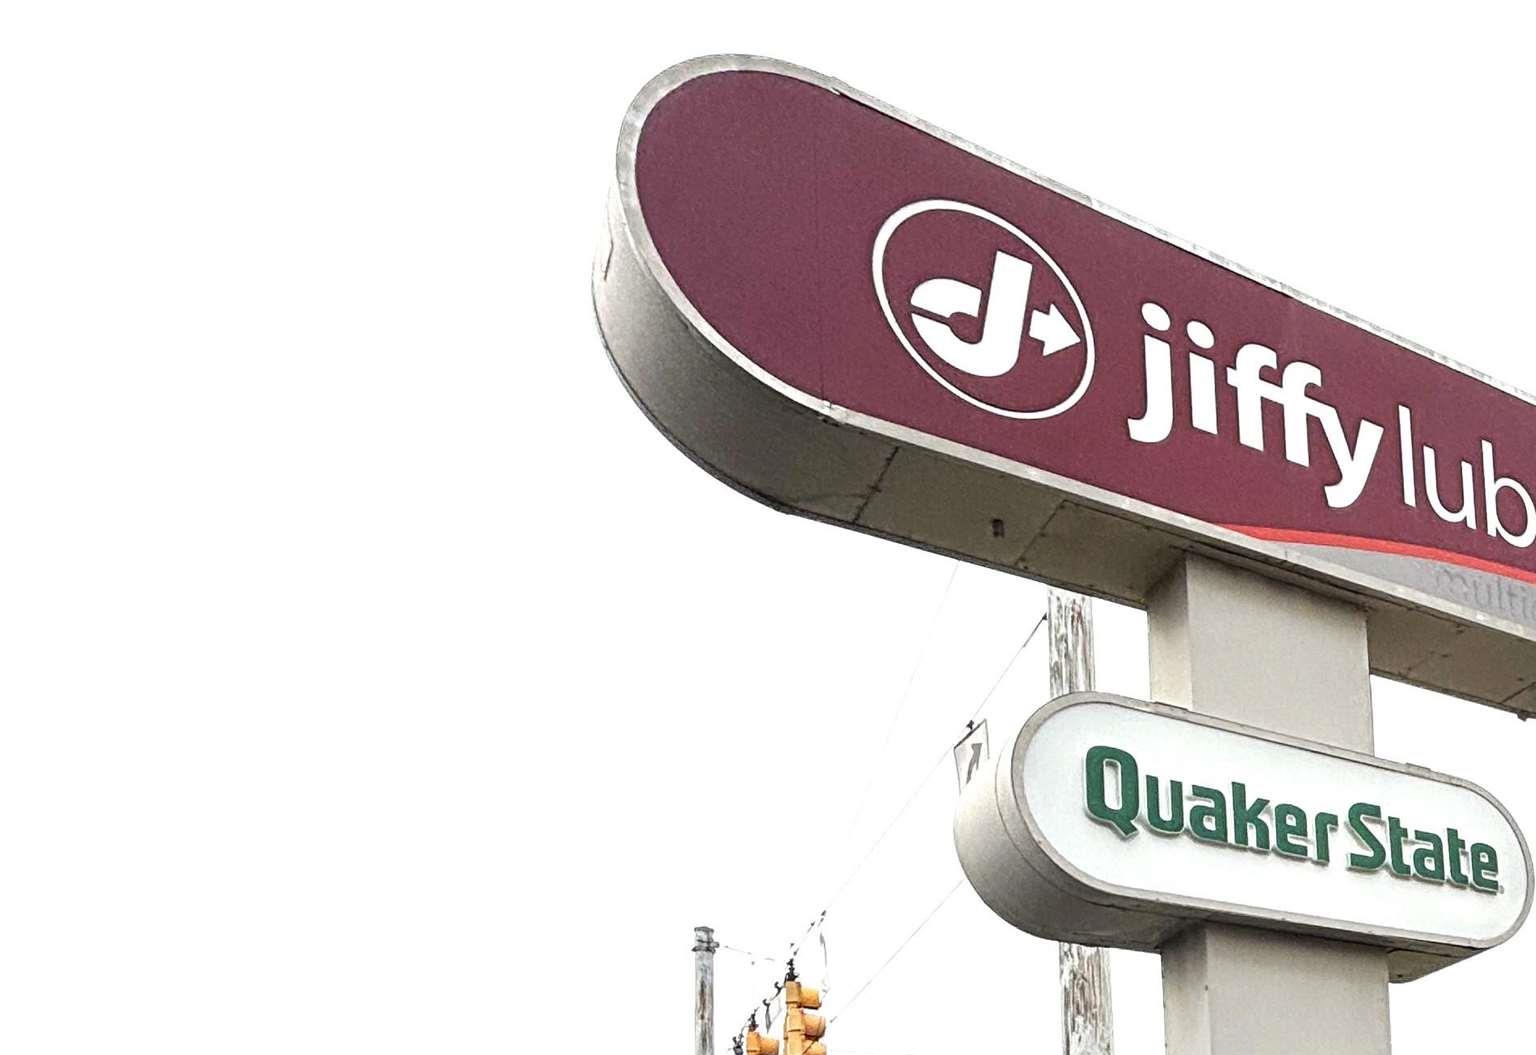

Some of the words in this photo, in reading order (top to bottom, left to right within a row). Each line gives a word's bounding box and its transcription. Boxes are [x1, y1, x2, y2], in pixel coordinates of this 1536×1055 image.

[1127, 302, 1385, 509] jiffy
[1084, 745, 1339, 865] Quaker
[1346, 802, 1501, 894] State
